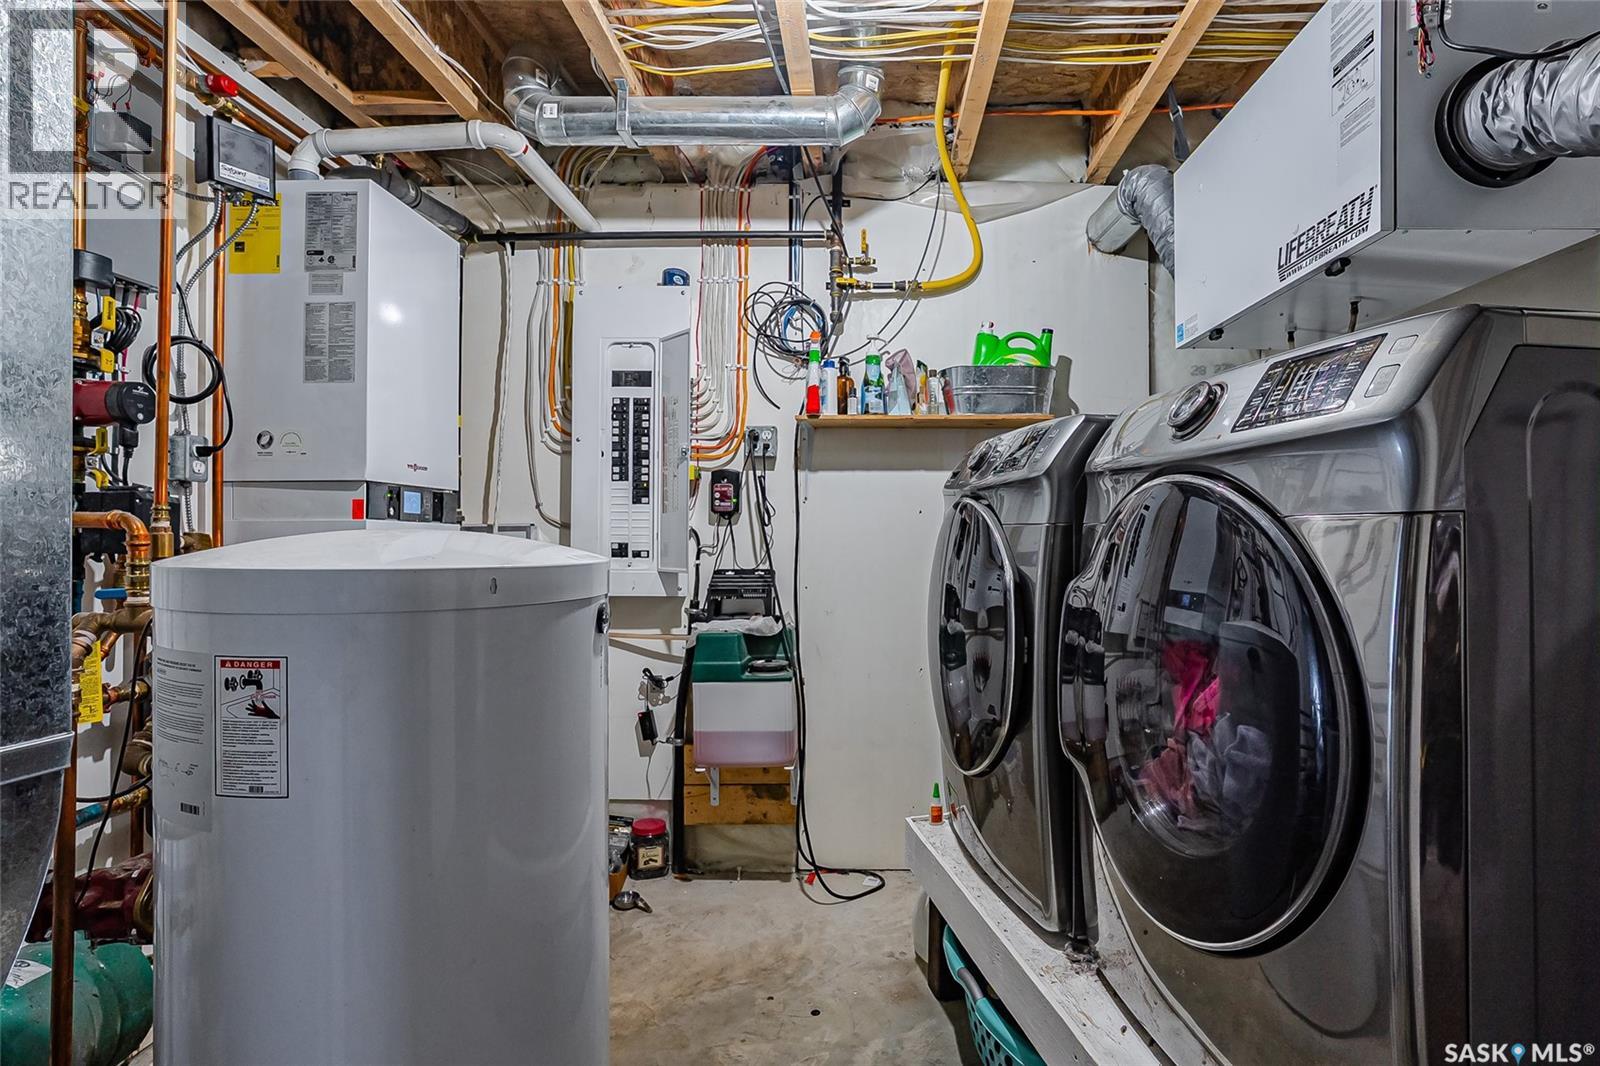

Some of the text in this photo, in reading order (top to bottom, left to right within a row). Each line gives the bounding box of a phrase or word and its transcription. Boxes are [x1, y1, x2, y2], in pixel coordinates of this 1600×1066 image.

[1278, 186, 1375, 271] LIFEBREATH
[1286, 224, 1369, 278] WWW.LIFEBREATH.COM
[233, 661, 273, 669] DANGER
